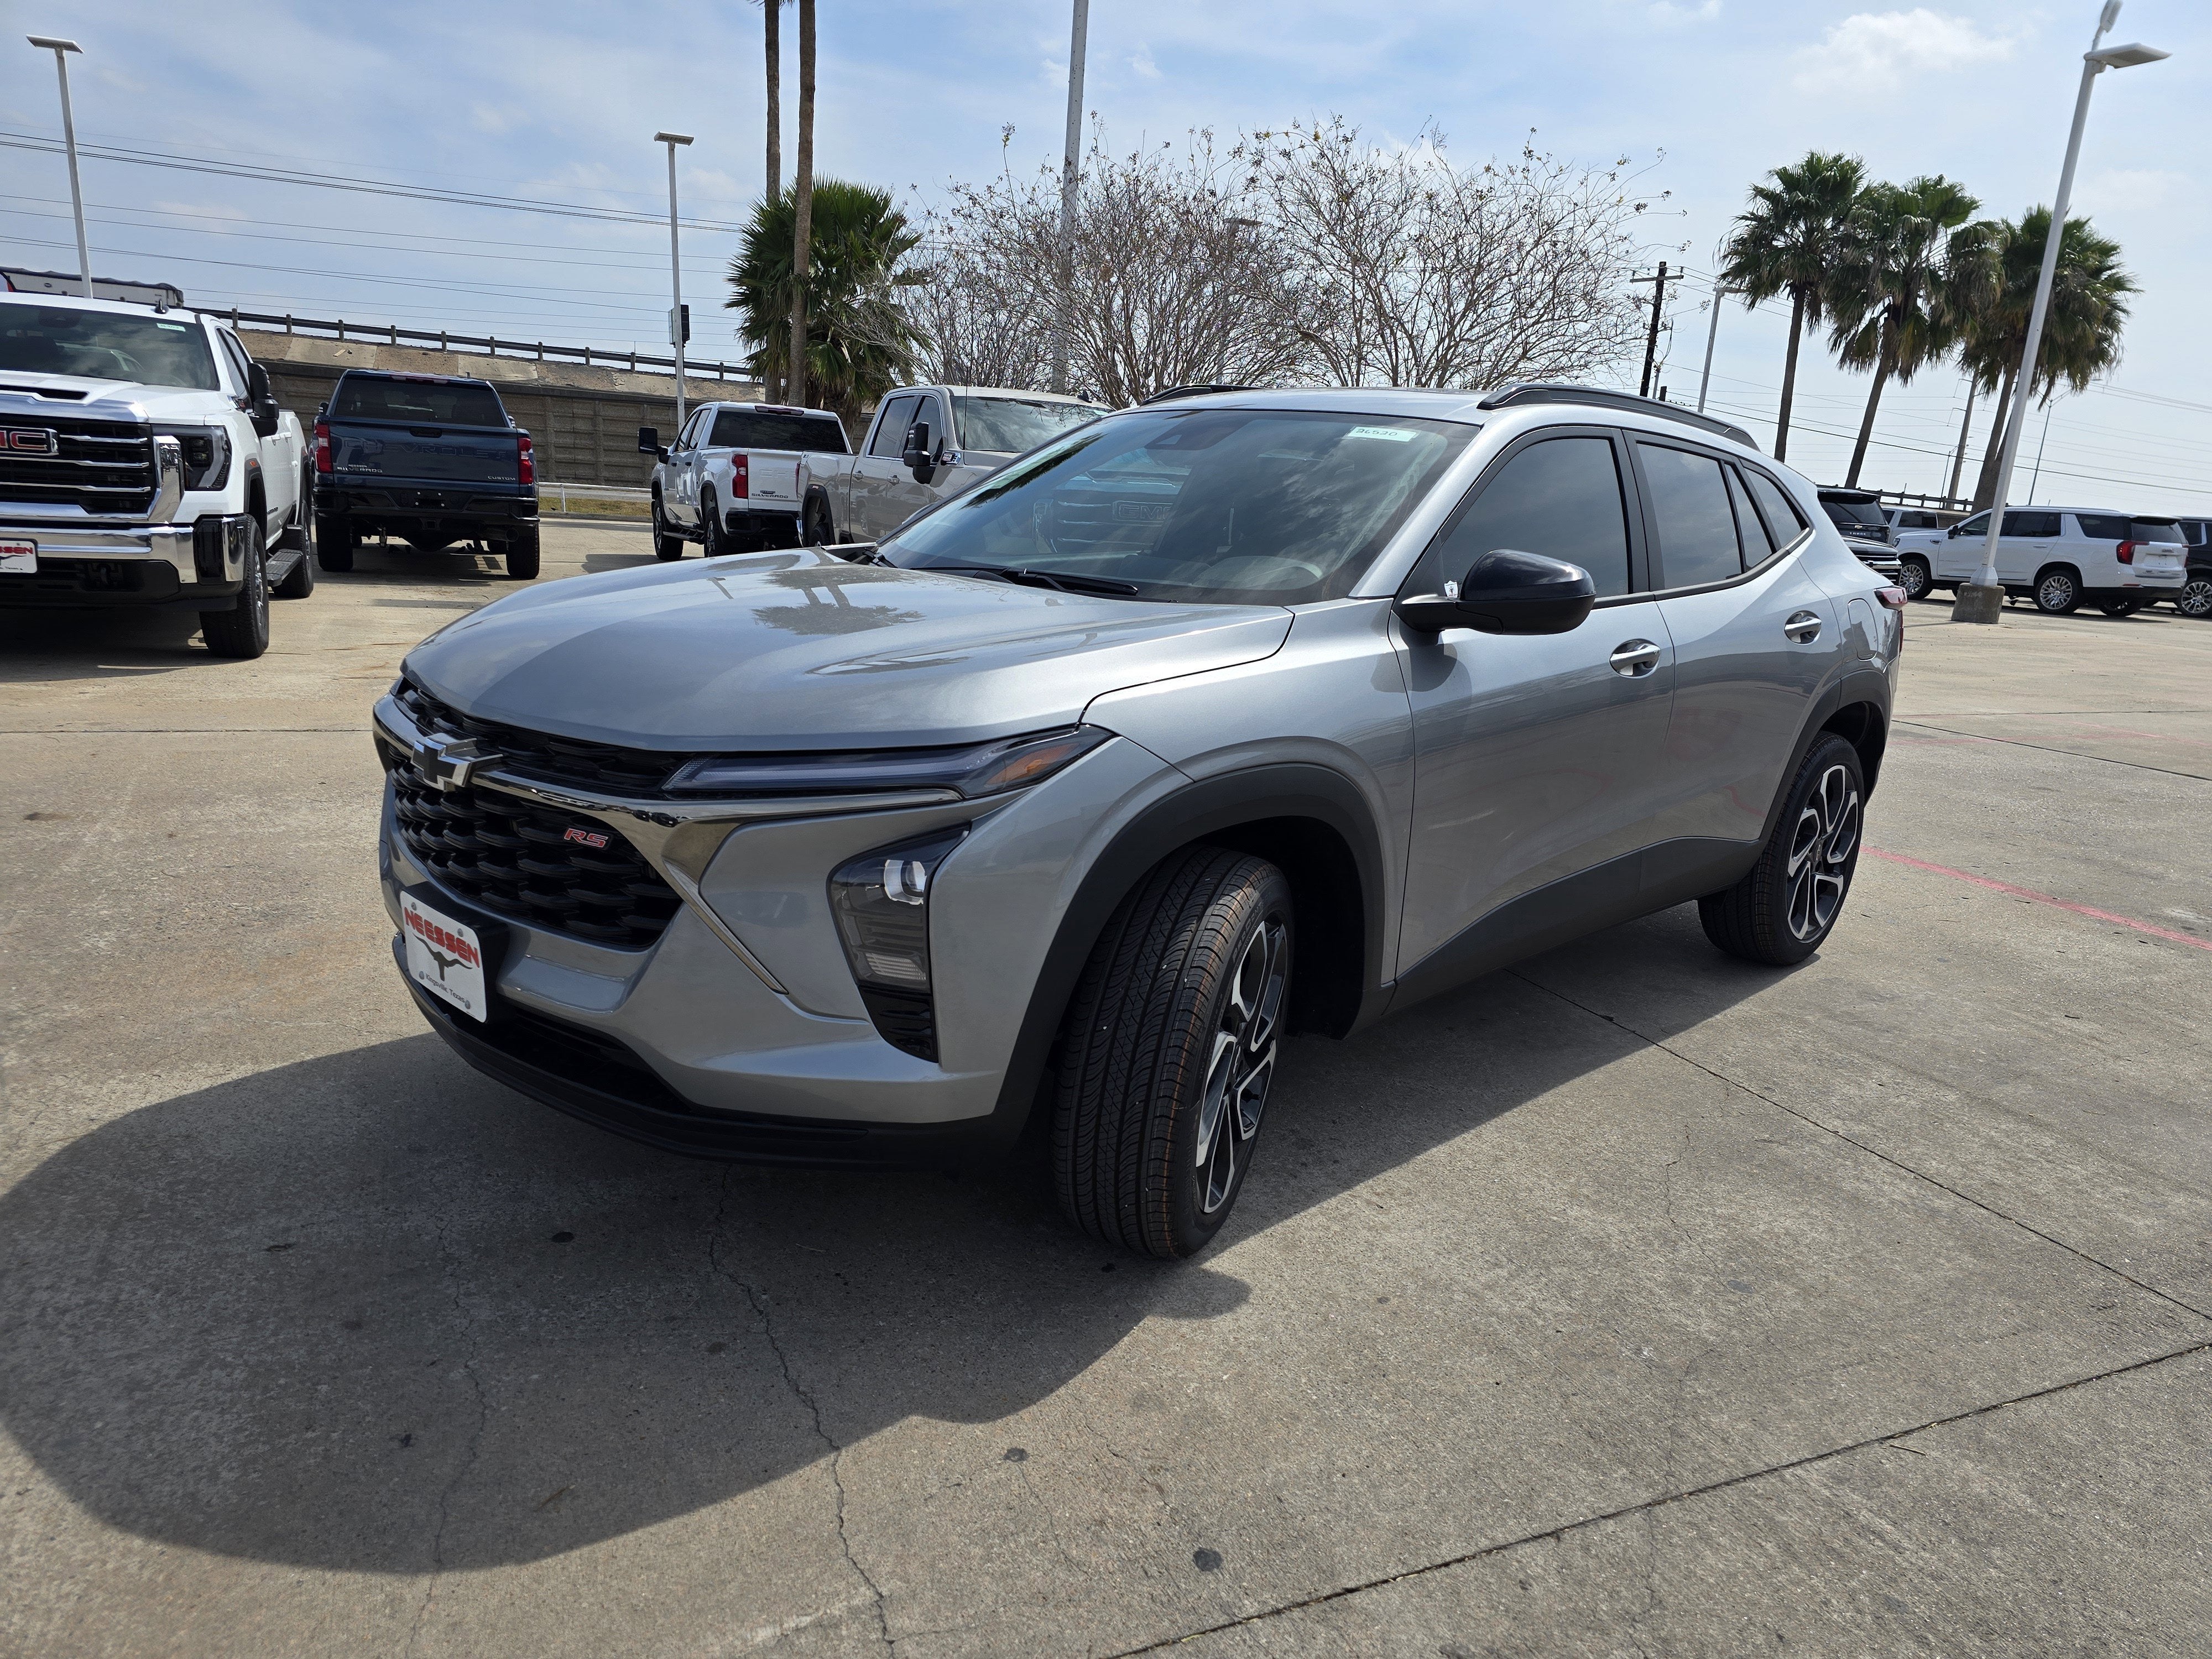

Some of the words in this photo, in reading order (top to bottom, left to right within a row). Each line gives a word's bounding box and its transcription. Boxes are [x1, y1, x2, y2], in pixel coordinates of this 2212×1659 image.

[564, 828, 608, 848] RS
[404, 907, 480, 968] NEESSEN
[449, 988, 465, 1003] Texas
